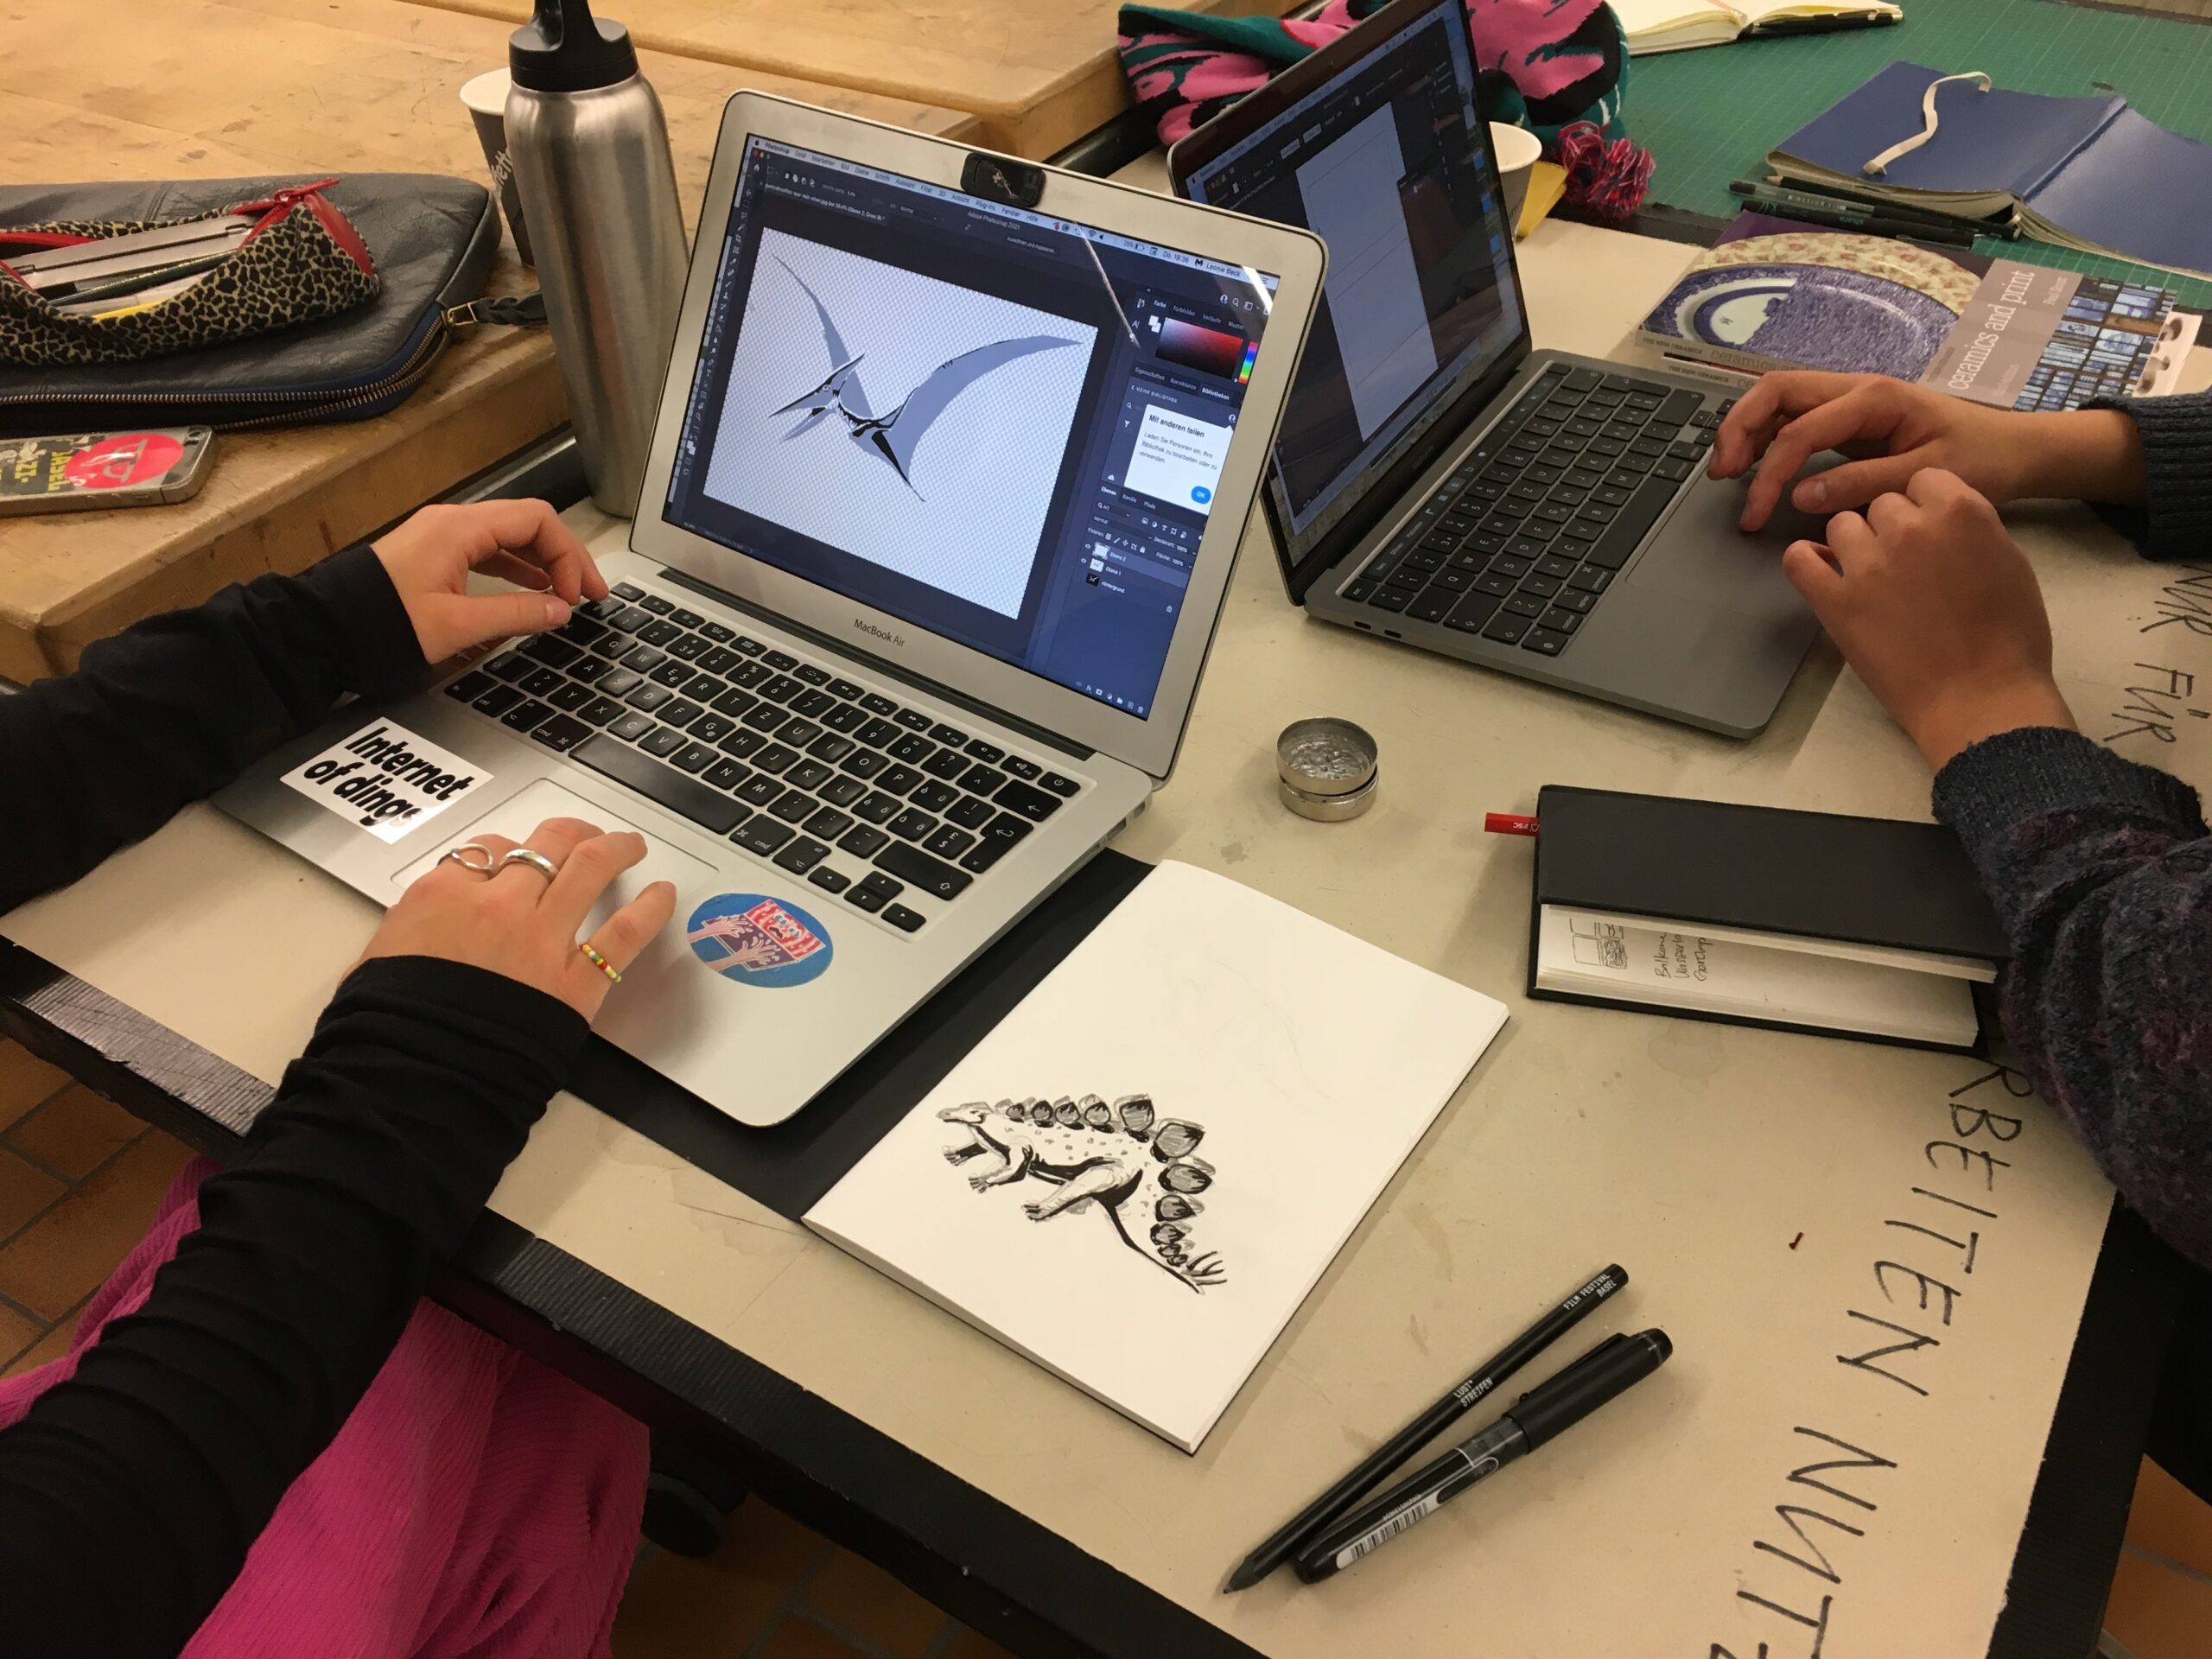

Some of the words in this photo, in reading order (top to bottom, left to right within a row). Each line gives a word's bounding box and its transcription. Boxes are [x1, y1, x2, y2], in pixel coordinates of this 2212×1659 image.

[1226, 265, 1241, 276] Beck
[1948, 331, 1999, 391] ceramics
[1985, 302, 2017, 333] and
[2001, 270, 2035, 307] print
[1710, 348, 1778, 372] ceramics
[1202, 387, 1230, 400] Bibliotheken
[1149, 414, 1160, 424] Mit
[1160, 416, 1185, 432] anderen
[1186, 426, 1205, 438] teilen
[1141, 441, 1165, 454] Bibliothek
[1173, 449, 1198, 464] bearbeiten
[1198, 459, 1211, 467] oder
[1144, 431, 1160, 442] Laden
[1169, 437, 1192, 452] Personen
[854, 619, 893, 642] MacBook
[893, 635, 906, 647] Air
[2102, 662, 2211, 743] FÜR
[303, 760, 365, 785] of
[344, 726, 476, 801] Internet
[333, 772, 423, 827] dings
[754, 839, 770, 849] cmd
[1837, 1063, 2035, 1398] RBEITEN
[1563, 1295, 1582, 1311] FILM
[1580, 1274, 1611, 1296] FESTIVAL
[1596, 1280, 1617, 1298] BASEL
[1460, 1376, 1493, 1408] STREIFEN
